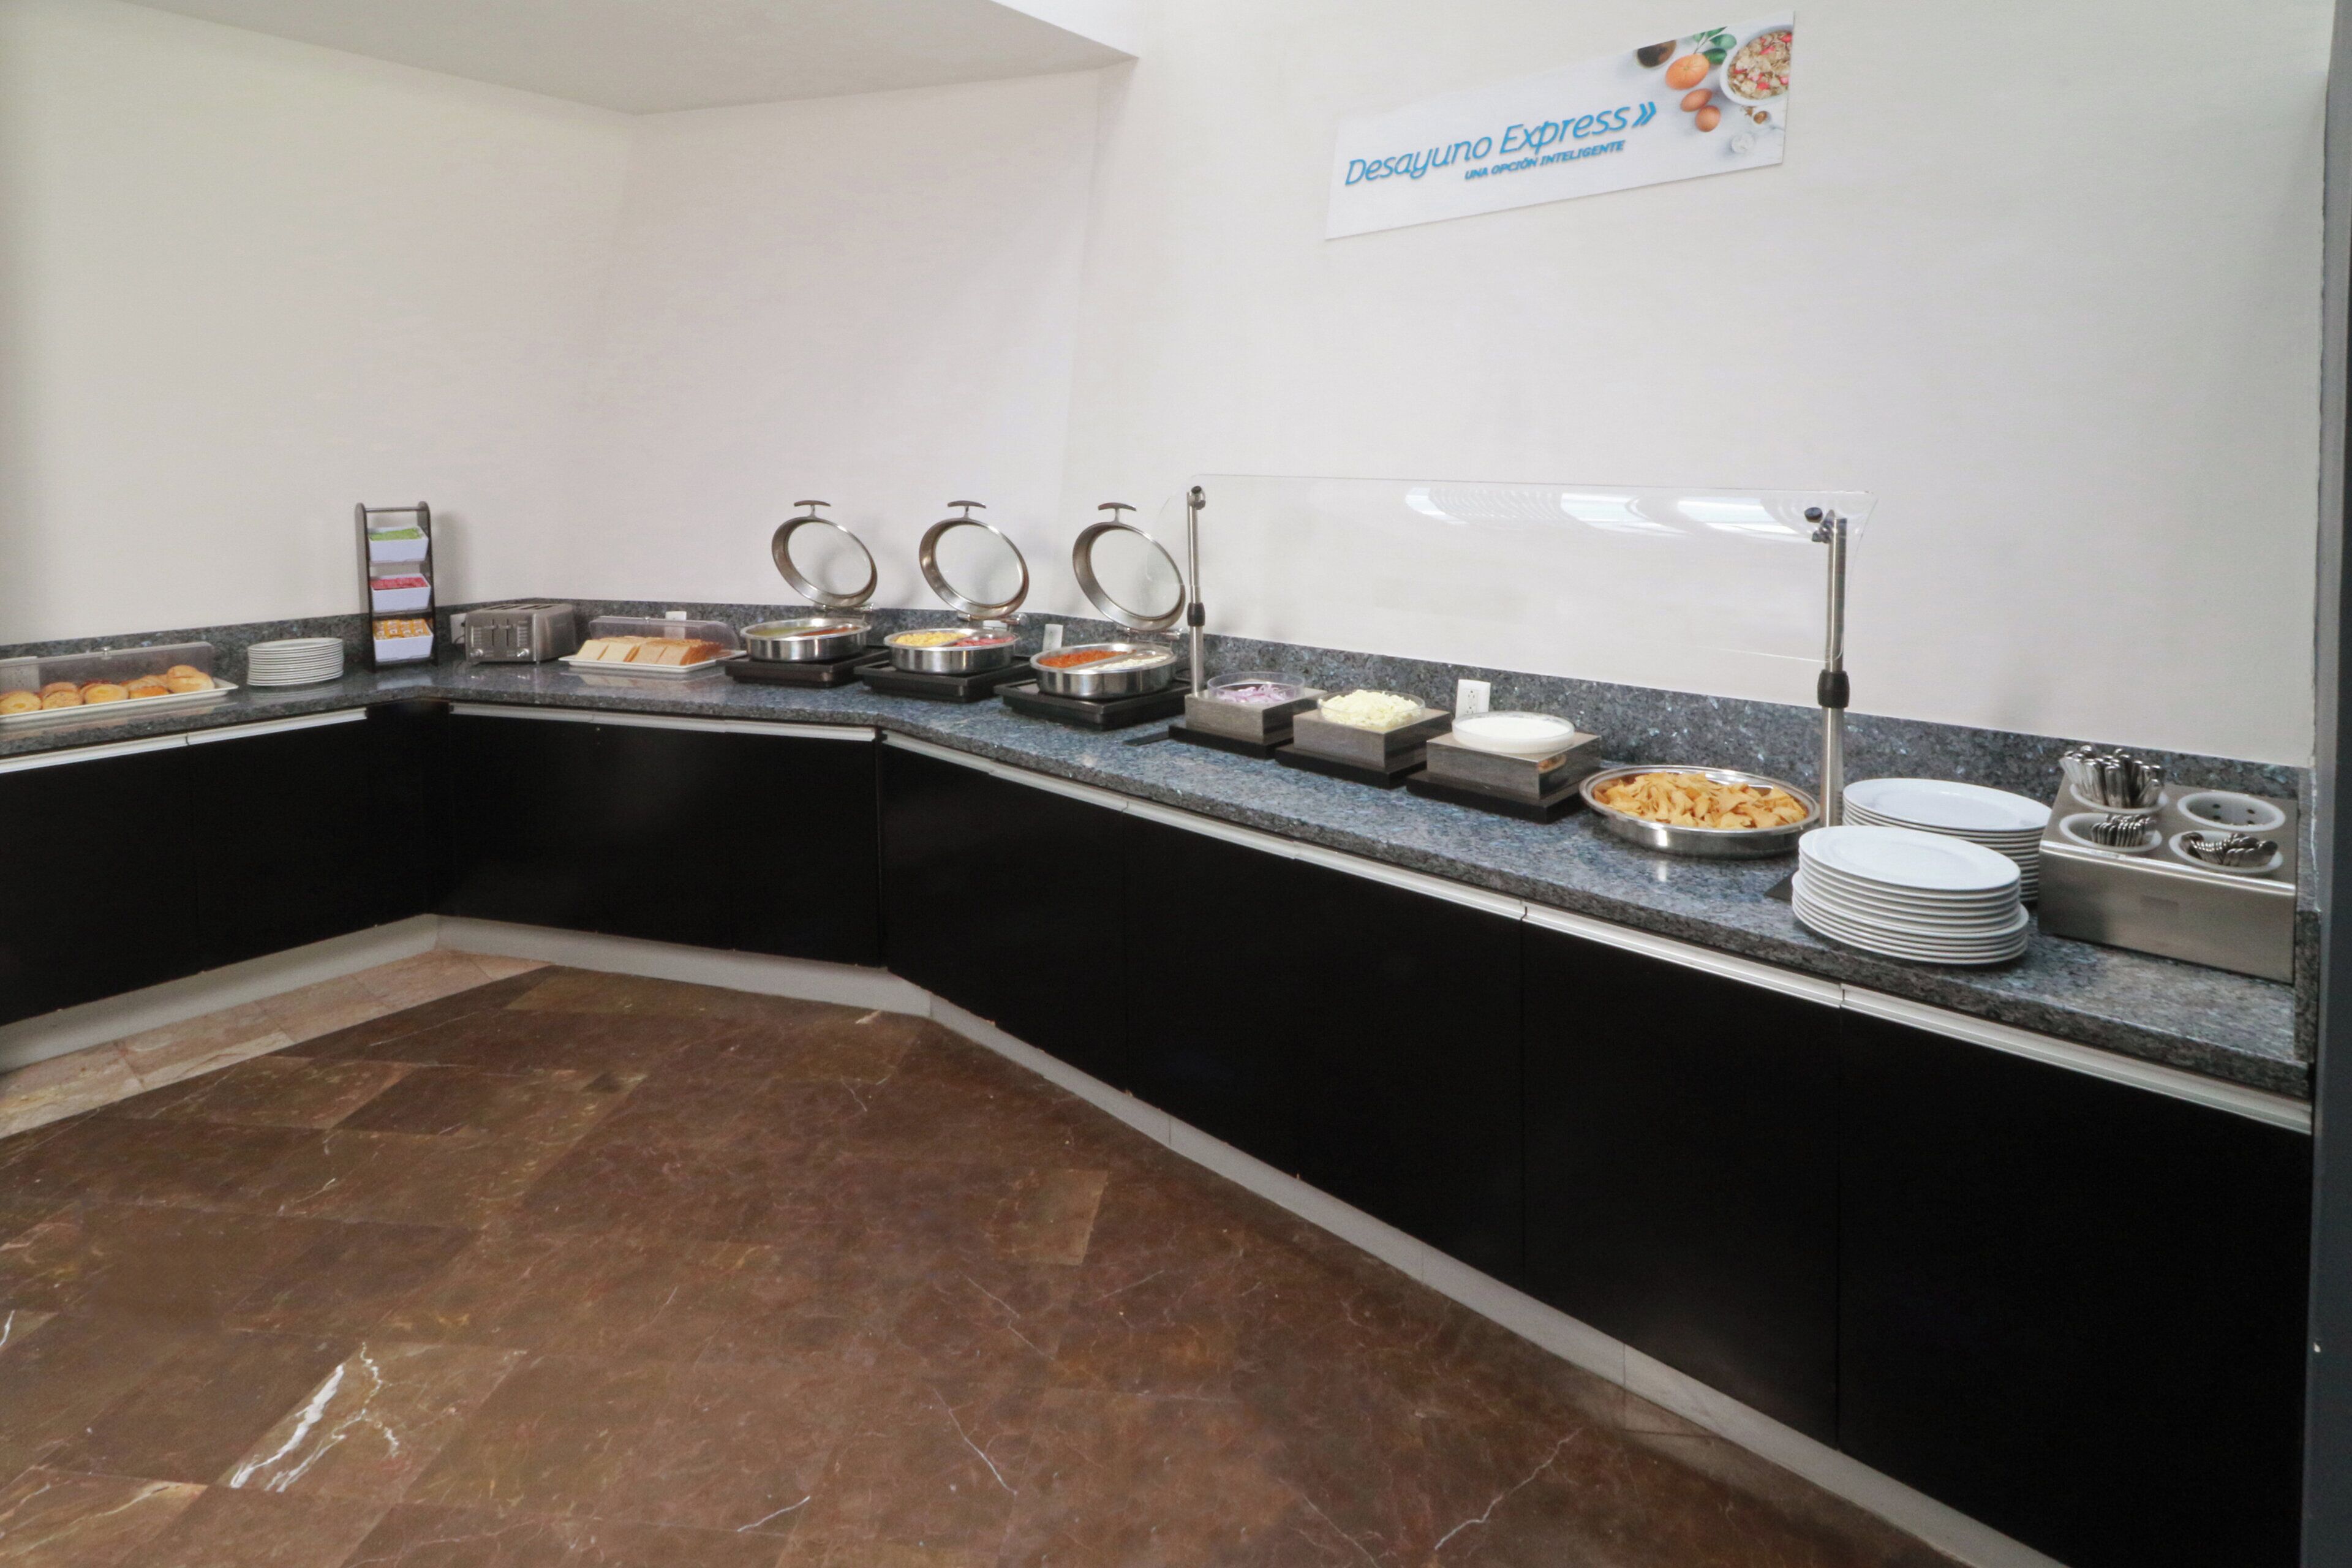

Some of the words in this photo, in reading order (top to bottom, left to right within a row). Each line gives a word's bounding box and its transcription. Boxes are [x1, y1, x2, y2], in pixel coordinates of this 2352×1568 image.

[1344, 136, 1493, 186] Desayuno
[1498, 105, 1631, 155] Express
[1464, 166, 1489, 181] UNA
[1491, 157, 1539, 175] OPCIÓN
[1539, 140, 1626, 167] INTELIGENTE
